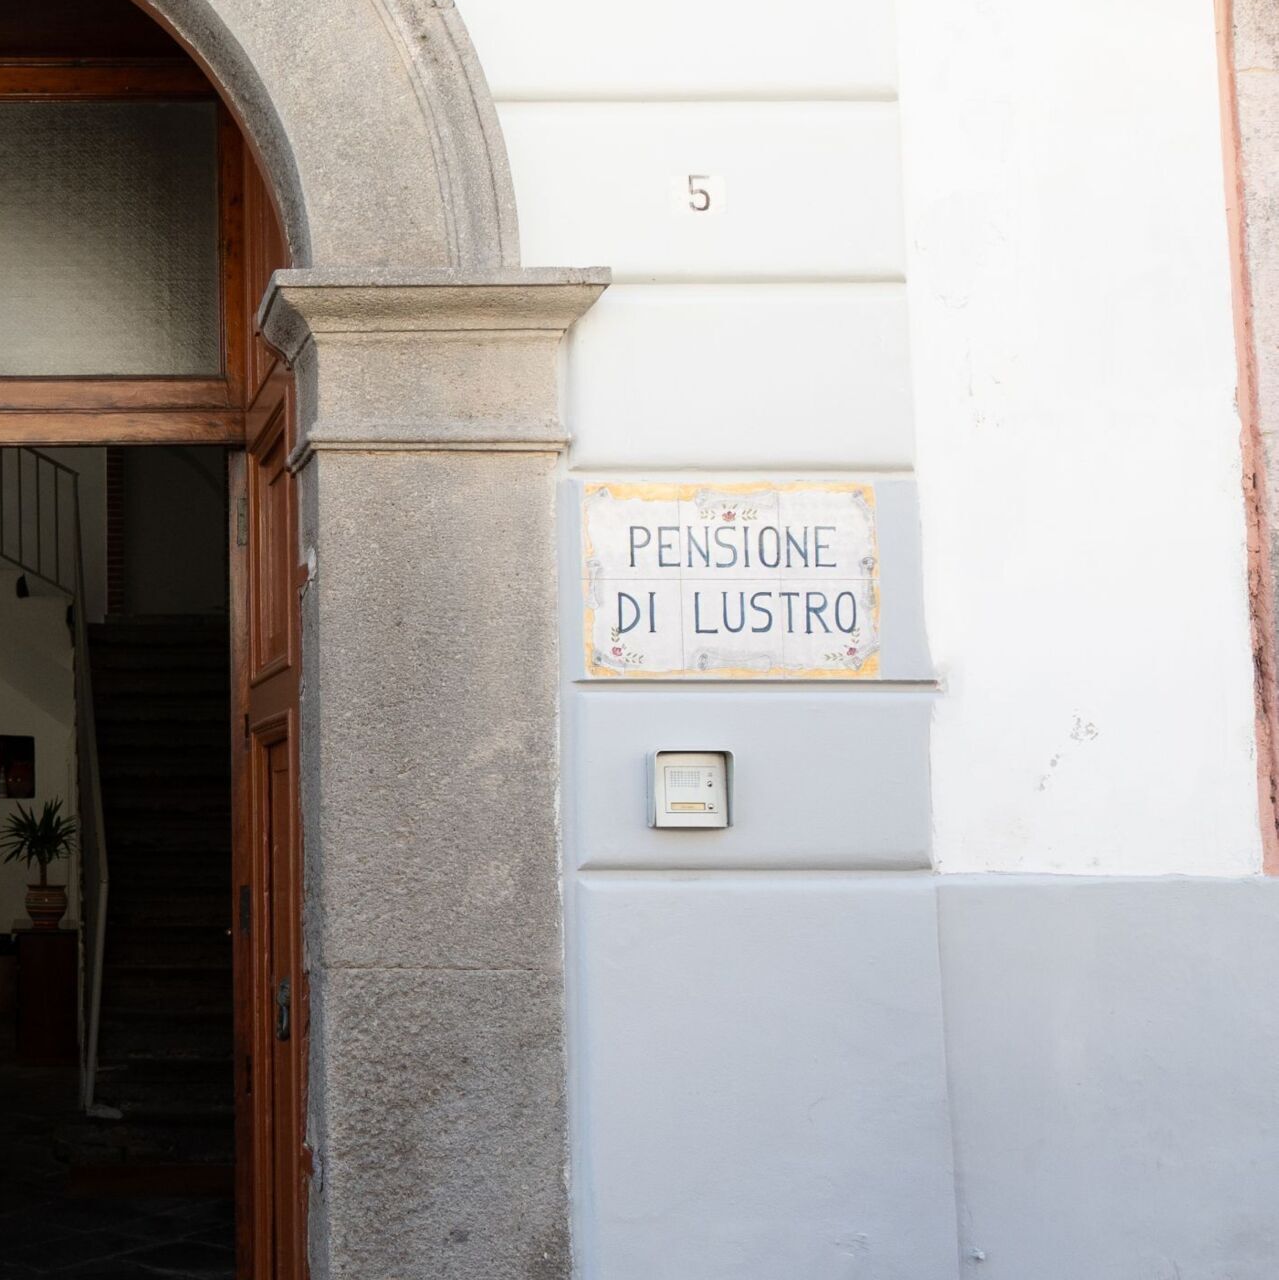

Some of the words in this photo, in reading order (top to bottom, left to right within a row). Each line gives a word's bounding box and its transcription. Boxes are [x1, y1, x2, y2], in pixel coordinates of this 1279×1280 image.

[688, 175, 710, 212] 5
[628, 525, 837, 569] PENSIONE
[617, 591, 657, 634] DI
[694, 591, 857, 635] LUSTRO
